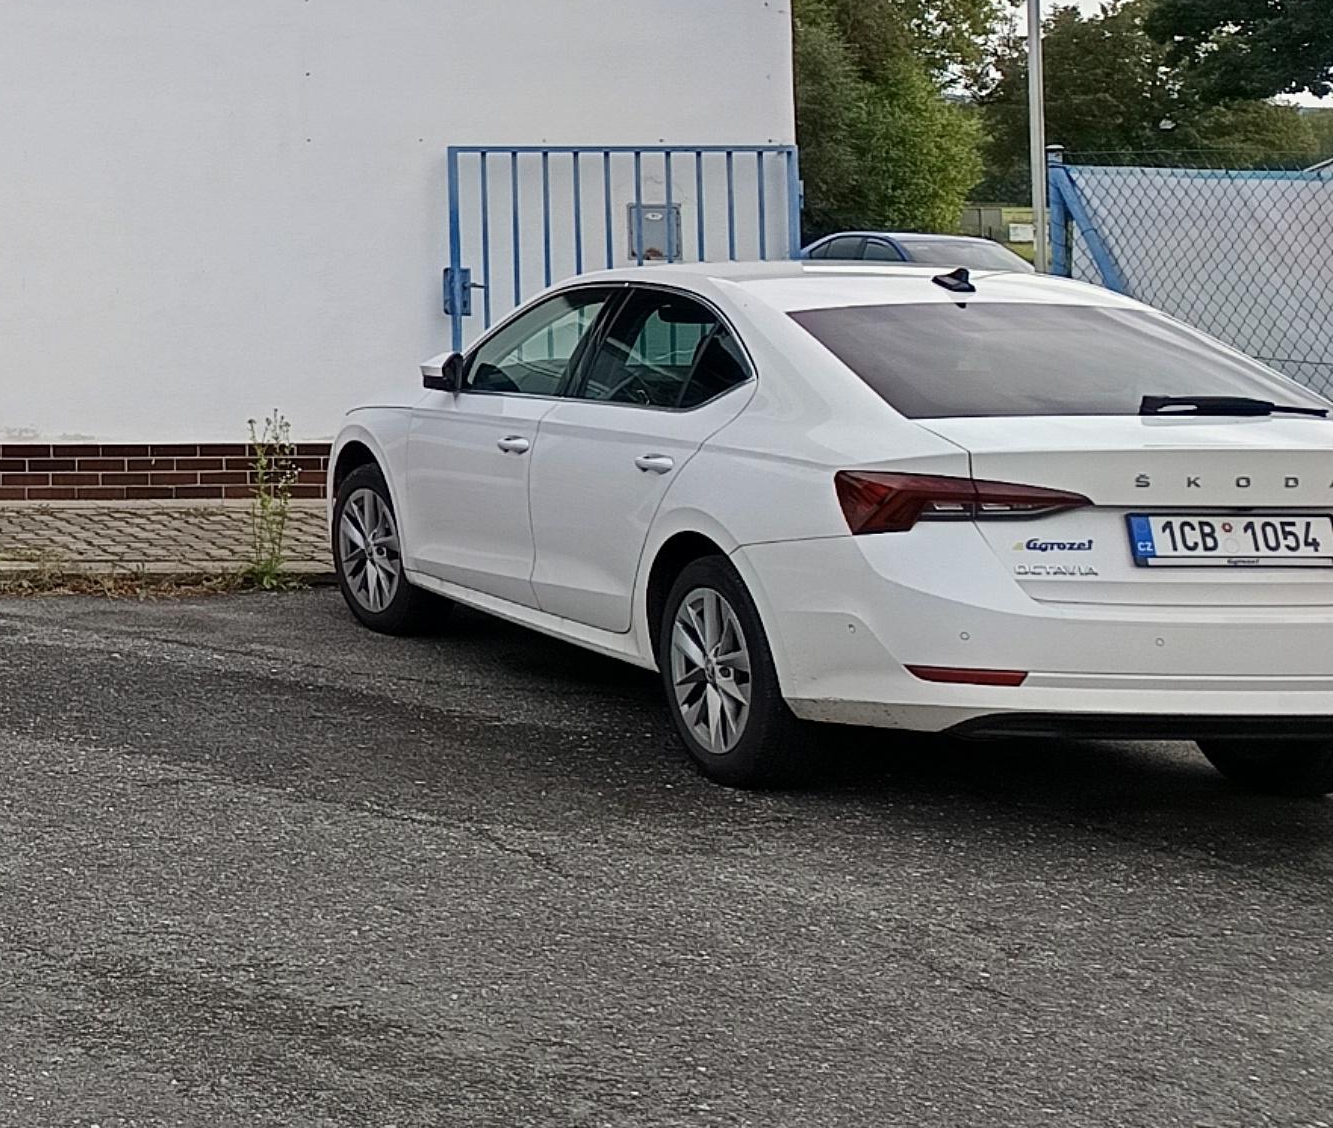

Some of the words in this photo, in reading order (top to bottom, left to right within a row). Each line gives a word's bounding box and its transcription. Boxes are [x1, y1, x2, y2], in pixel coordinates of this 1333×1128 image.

[1135, 474, 1333, 488] ŠKOD
[1162, 520, 1218, 552] 1CB
[1243, 521, 1320, 552] 1054
[1138, 542, 1153, 551] CZ
[1014, 565, 1099, 576] OCTAVIA
